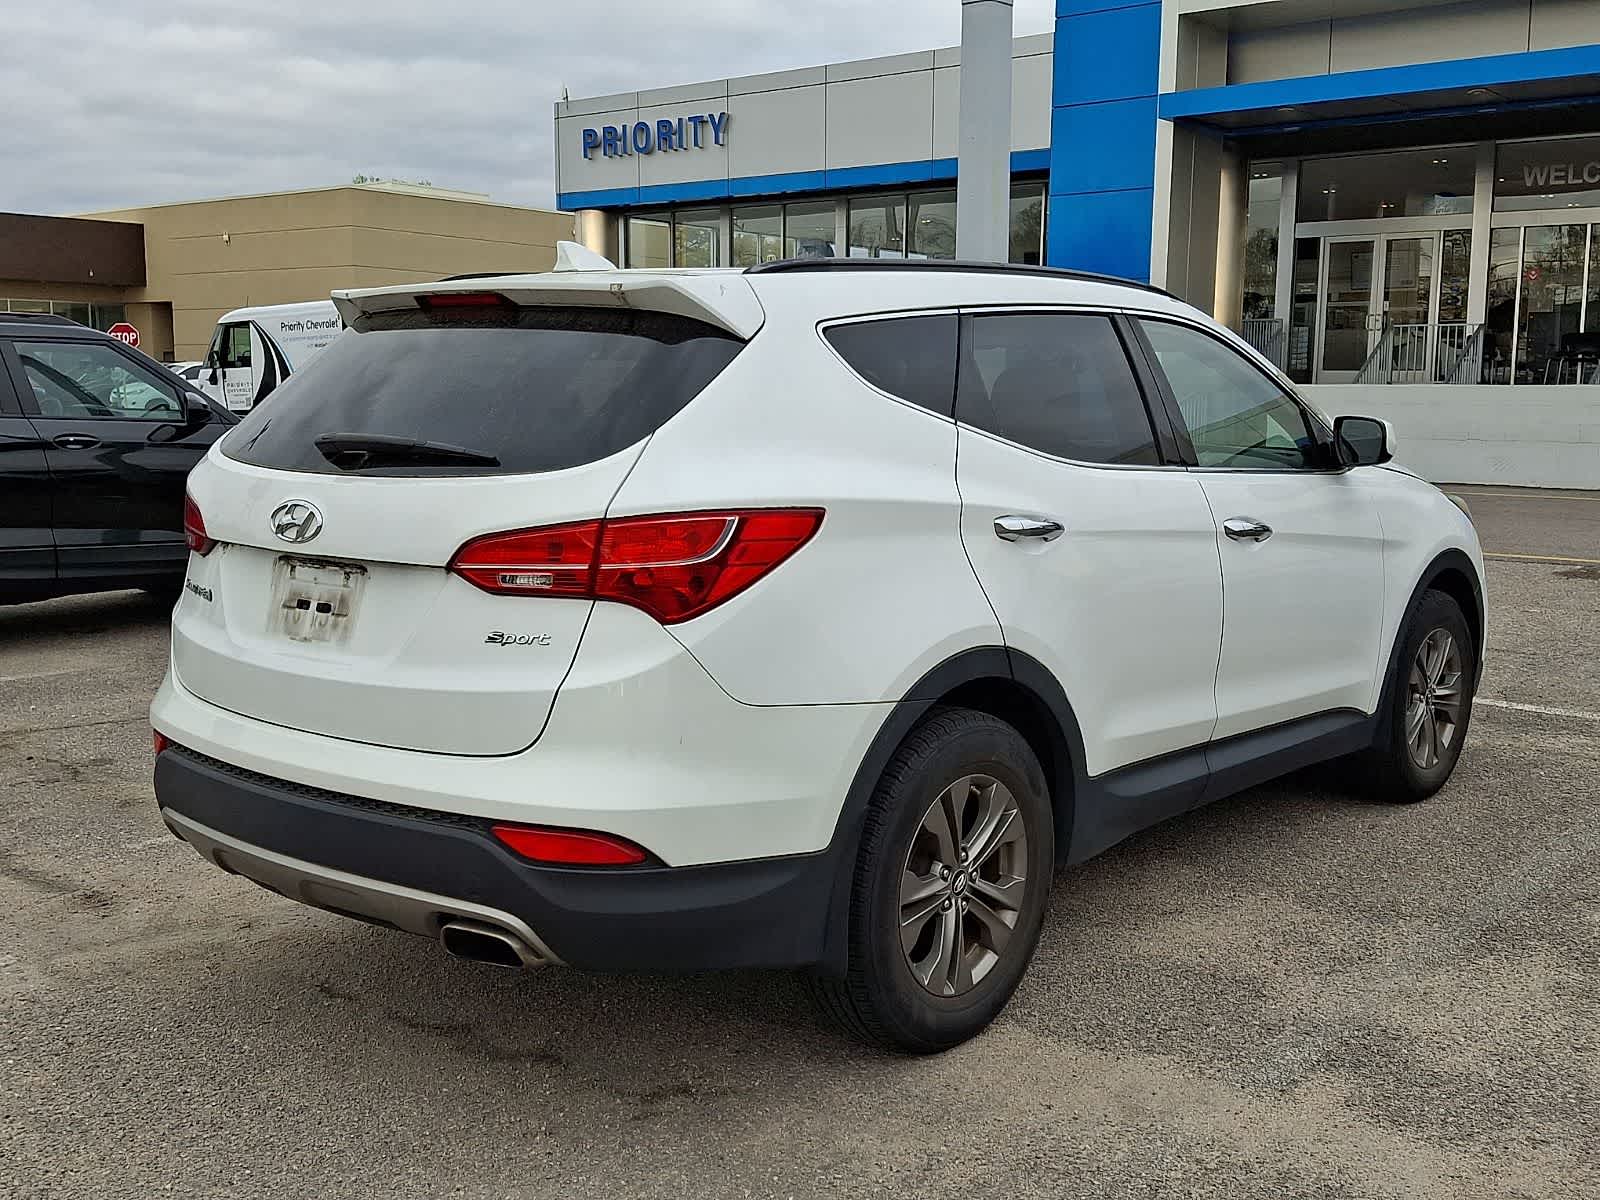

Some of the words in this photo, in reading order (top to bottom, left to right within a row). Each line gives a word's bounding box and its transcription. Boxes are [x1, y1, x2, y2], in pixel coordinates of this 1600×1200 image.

[581, 111, 730, 160] PRIORITY
[1523, 161, 1600, 187] WELC
[280, 320, 304, 332] Priority
[306, 317, 338, 330] Chevrolet
[484, 630, 552, 647] Sport
